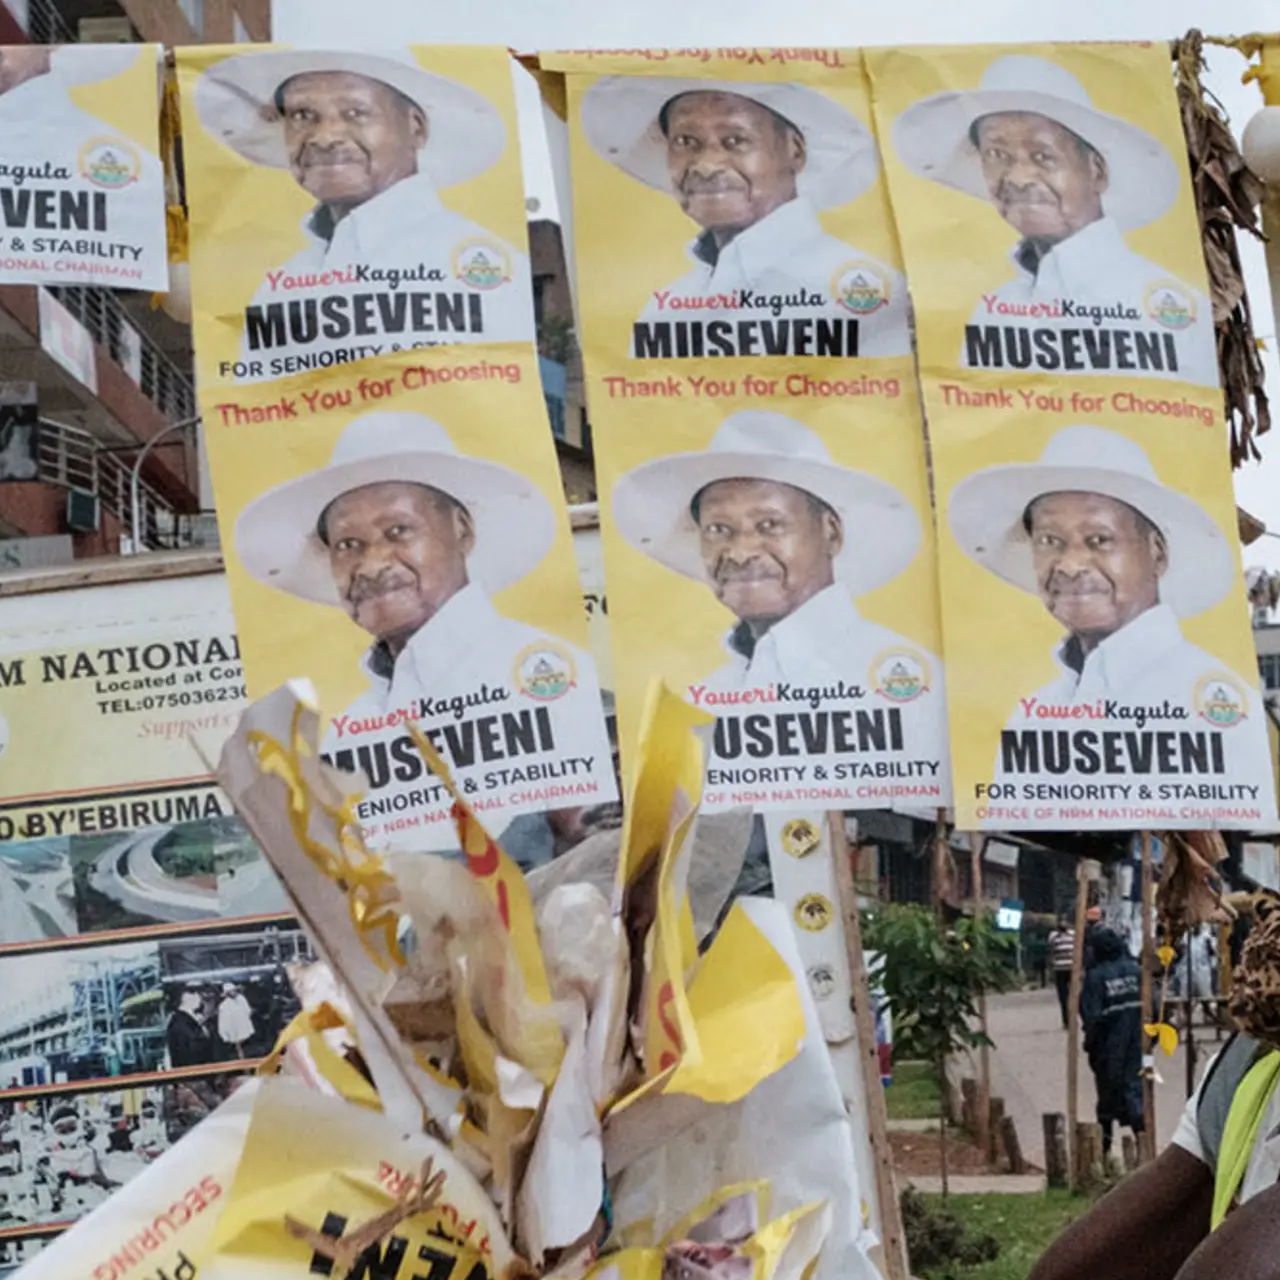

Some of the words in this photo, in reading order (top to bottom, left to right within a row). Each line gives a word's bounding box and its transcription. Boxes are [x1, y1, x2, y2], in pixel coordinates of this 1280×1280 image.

[10, 238, 25, 252] &
[33, 238, 144, 260] STABILITY
[245, 292, 483, 351] MUSEVENI
[634, 318, 859, 359] MUSEVENI
[965, 324, 1178, 373] MUSEVENI
[219, 360, 264, 378] FOR
[215, 402, 298, 428] Thank
[300, 390, 353, 413] You
[358, 379, 395, 401] for
[401, 361, 520, 392] Choosing
[603, 376, 682, 398] Thank
[687, 376, 736, 397] You
[743, 375, 778, 395] for
[785, 373, 900, 398] Choosing
[939, 384, 1013, 408] Thank
[1018, 390, 1063, 412] You
[1071, 391, 1104, 413] for
[1111, 392, 1214, 426] Choosing
[96, 674, 176, 694] Located
[184, 672, 202, 684] at
[714, 707, 904, 759] USEVENI
[1001, 730, 1225, 775] MUSEVENI
[484, 756, 595, 791] STABILITY
[708, 766, 805, 785] ENIORITY
[814, 766, 828, 781] &
[835, 760, 940, 779] STABILITY
[772, 788, 852, 800] NATIONAL
[857, 785, 940, 798] CHAIRMAN
[976, 784, 1016, 799] FOR
[1023, 785, 1131, 800] SENIORITY
[1138, 785, 1152, 799] &
[1158, 785, 1259, 800] STABILITY
[1098, 808, 1176, 819] NATIONAL
[1180, 808, 1261, 820] CHAIRMAN
